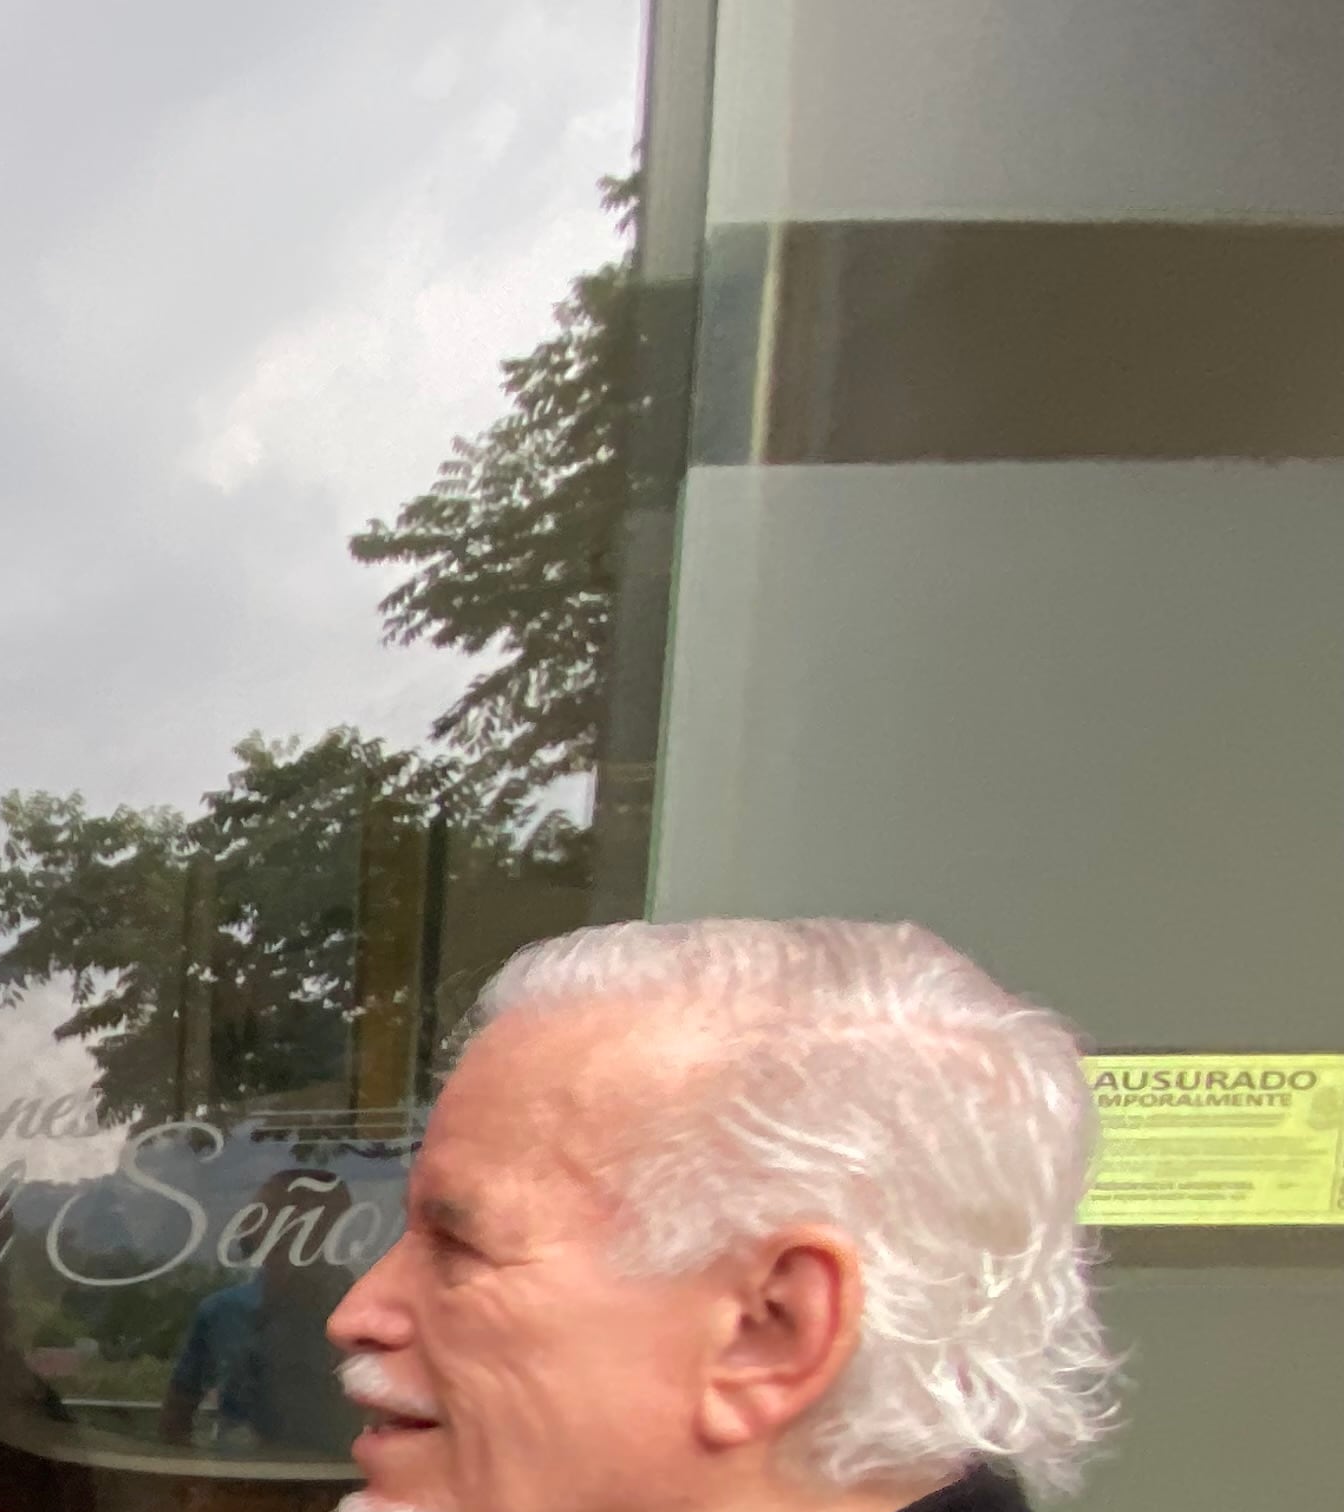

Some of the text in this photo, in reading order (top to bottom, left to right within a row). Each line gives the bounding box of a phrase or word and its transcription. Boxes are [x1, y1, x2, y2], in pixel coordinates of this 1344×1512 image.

[1093, 1070, 1318, 1092] AUSURADO
[1097, 1092, 1293, 1108] MPORALMENTE
[46, 1121, 406, 1286] Seño
